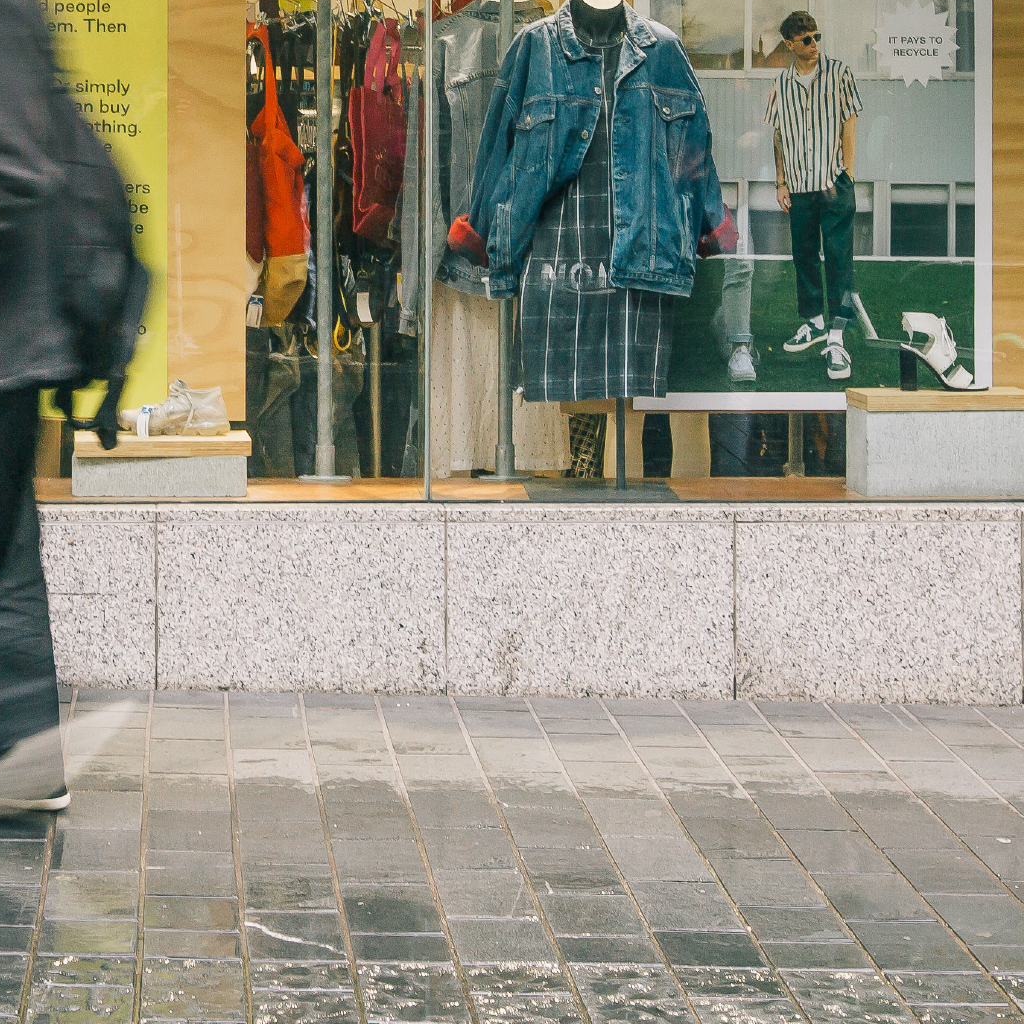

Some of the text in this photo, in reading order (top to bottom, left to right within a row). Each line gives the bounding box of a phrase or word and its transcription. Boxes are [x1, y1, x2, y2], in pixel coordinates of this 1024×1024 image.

[83, 18, 127, 33] Then
[888, 36, 943, 45] IT PAYS TO
[893, 48, 939, 57] RECYCLE
[75, 79, 131, 97] simply
[99, 99, 130, 117] buy
